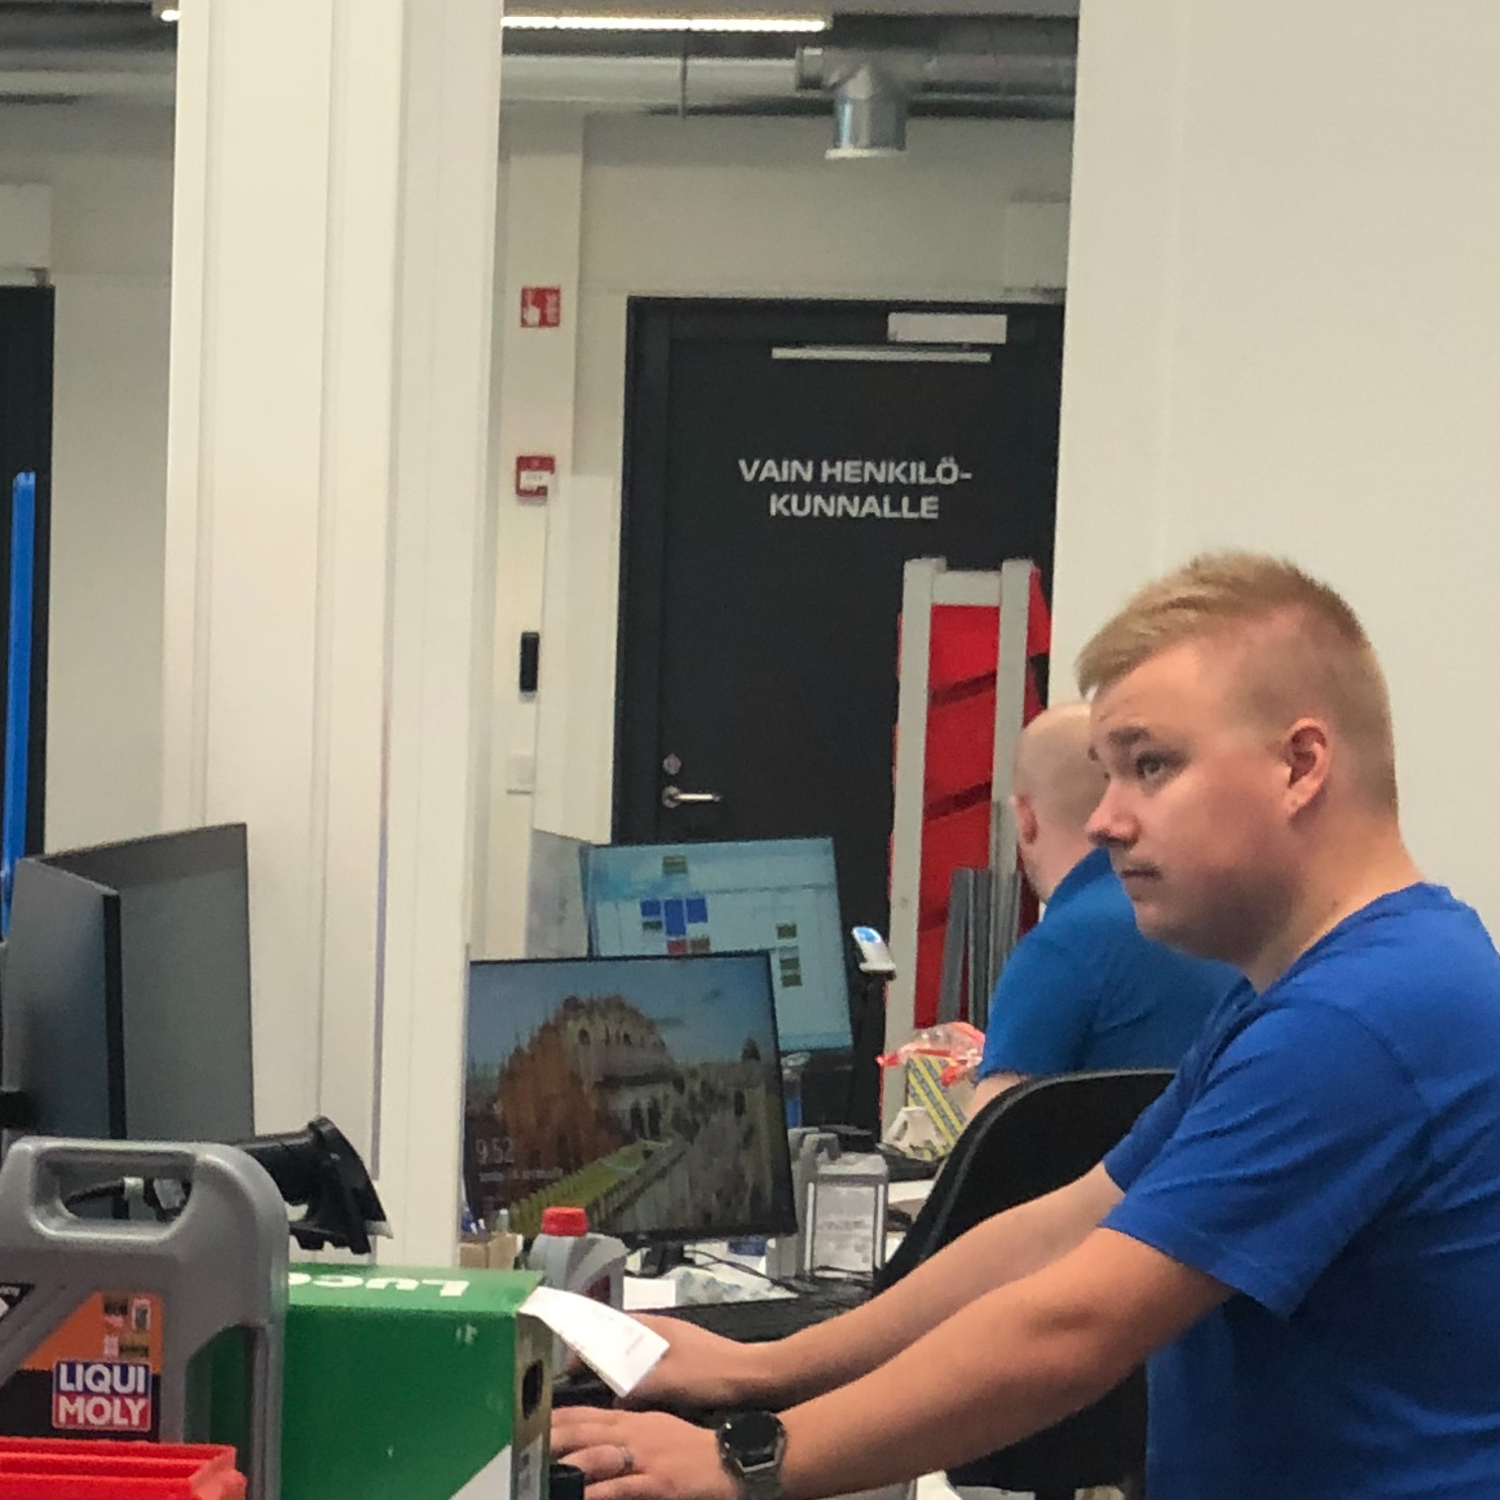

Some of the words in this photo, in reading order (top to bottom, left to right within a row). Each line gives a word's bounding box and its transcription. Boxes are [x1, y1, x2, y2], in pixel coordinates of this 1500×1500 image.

[738, 458, 813, 482] VAIN
[820, 456, 972, 484] HENKILÖ-
[769, 492, 939, 519] KUNNALLE
[60, 1363, 146, 1395] LIQUI
[59, 1395, 147, 1426] MOLY
